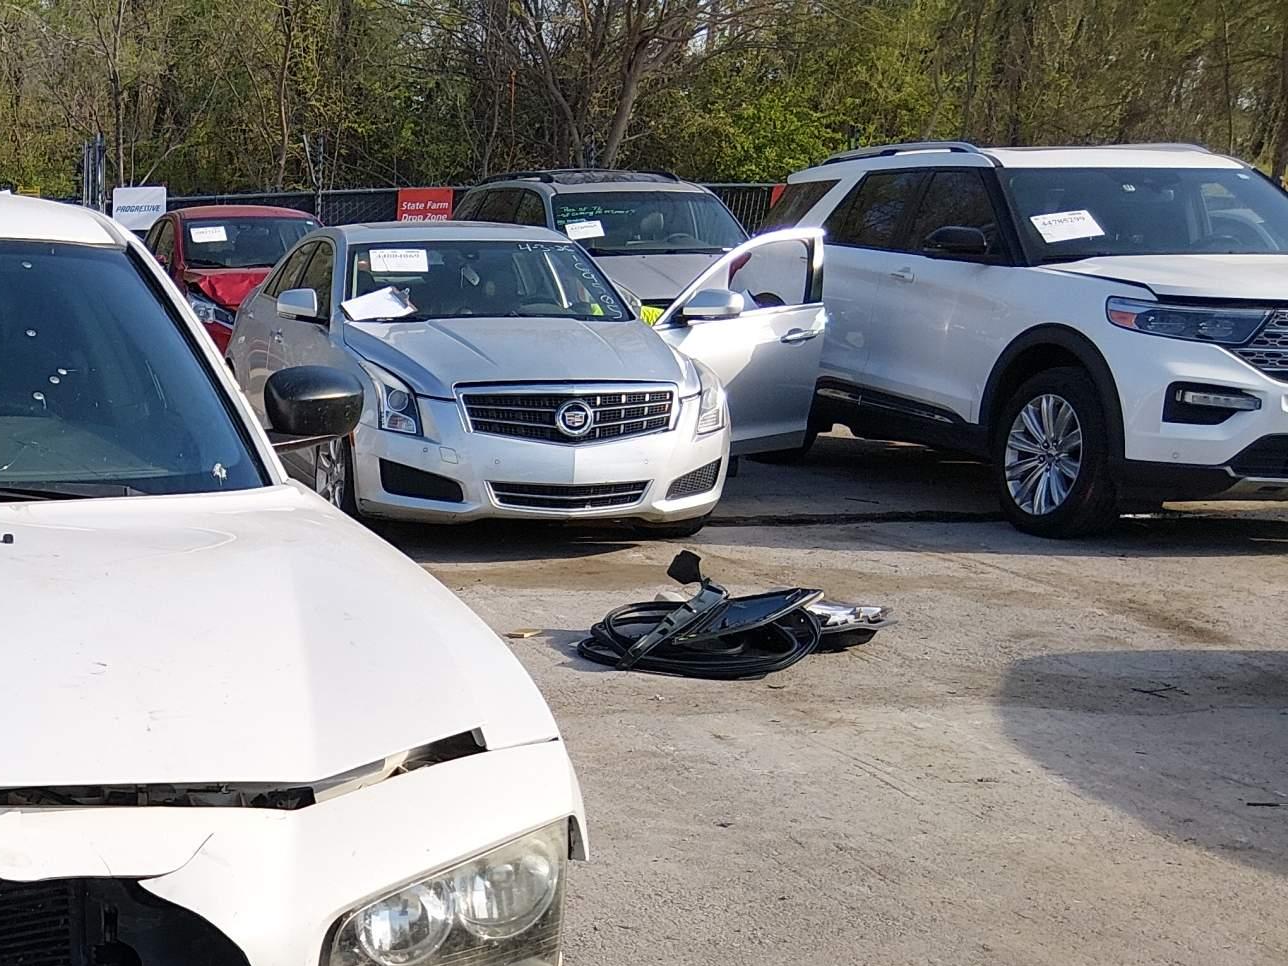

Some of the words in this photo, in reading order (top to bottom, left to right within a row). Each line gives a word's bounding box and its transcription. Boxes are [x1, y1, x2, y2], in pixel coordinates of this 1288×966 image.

[115, 204, 161, 213] PROGRESSIVE
[400, 201, 425, 210] State
[426, 200, 449, 209] Farm
[401, 213, 424, 222] Drop
[423, 213, 448, 222] Zone
